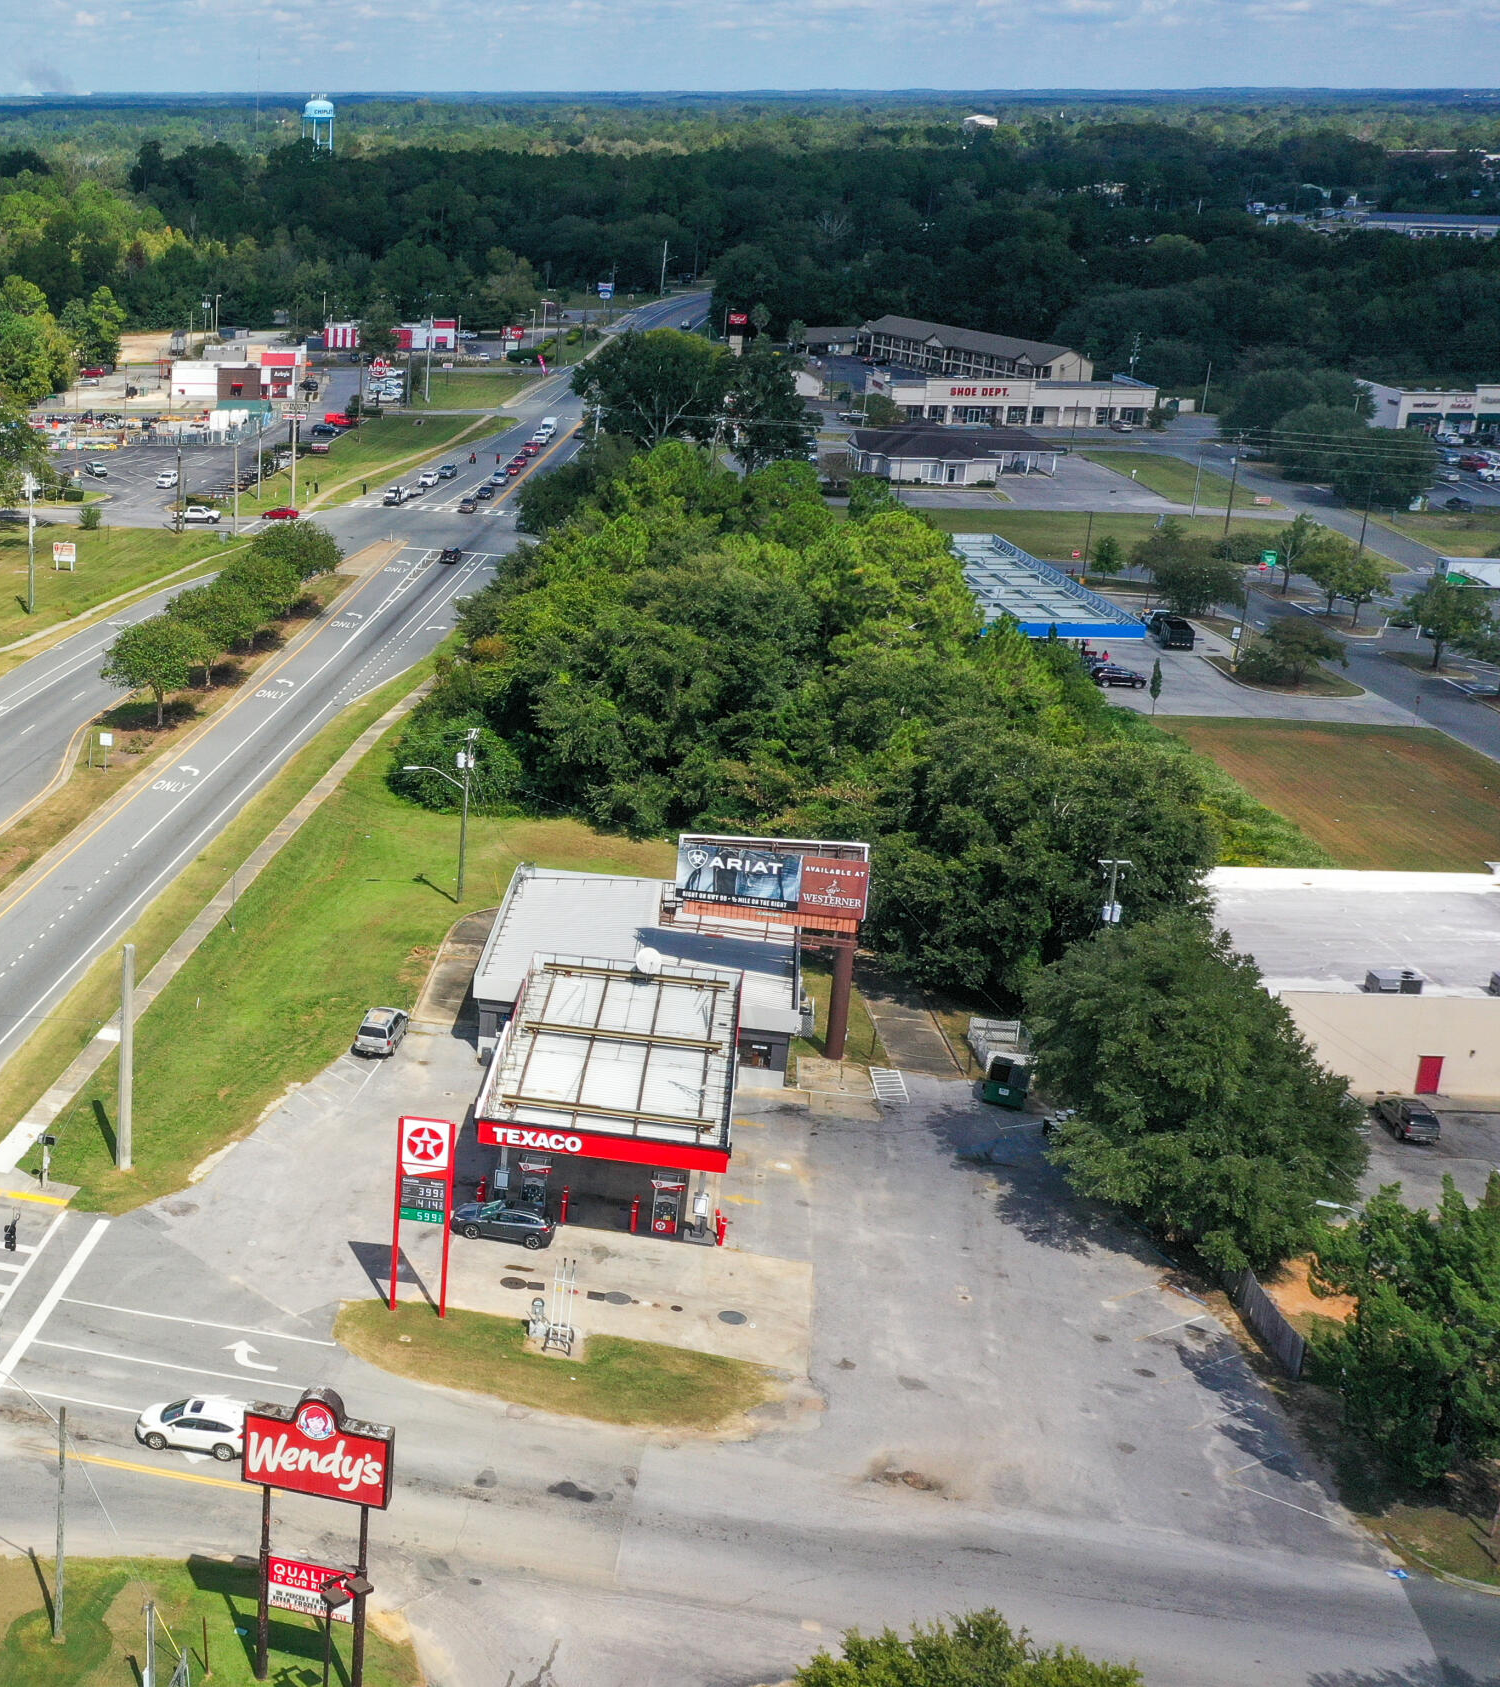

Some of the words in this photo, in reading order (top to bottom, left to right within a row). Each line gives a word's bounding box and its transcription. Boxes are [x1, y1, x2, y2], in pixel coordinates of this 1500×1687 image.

[950, 387, 977, 396] SHOE
[981, 387, 1010, 397] DEPT.
[383, 566, 410, 574] ONLY
[330, 620, 360, 629] ONLY
[255, 689, 289, 699] ONLY
[151, 779, 191, 793] ONLY
[708, 856, 784, 875] ARIAT
[805, 865, 852, 877] AVAILABLE
[682, 890, 698, 898] RIGHT
[707, 893, 719, 901] HWY
[770, 900, 787, 908] RIGHT
[802, 892, 861, 907] WESTERNER
[492, 1126, 583, 1153] TEXACO
[248, 1431, 383, 1492] Wendy's
[273, 1574, 283, 1582] IS
[286, 1575, 307, 1588] OUR
[271, 1600, 290, 1609] OPEN
[290, 1604, 305, 1612] FOR
